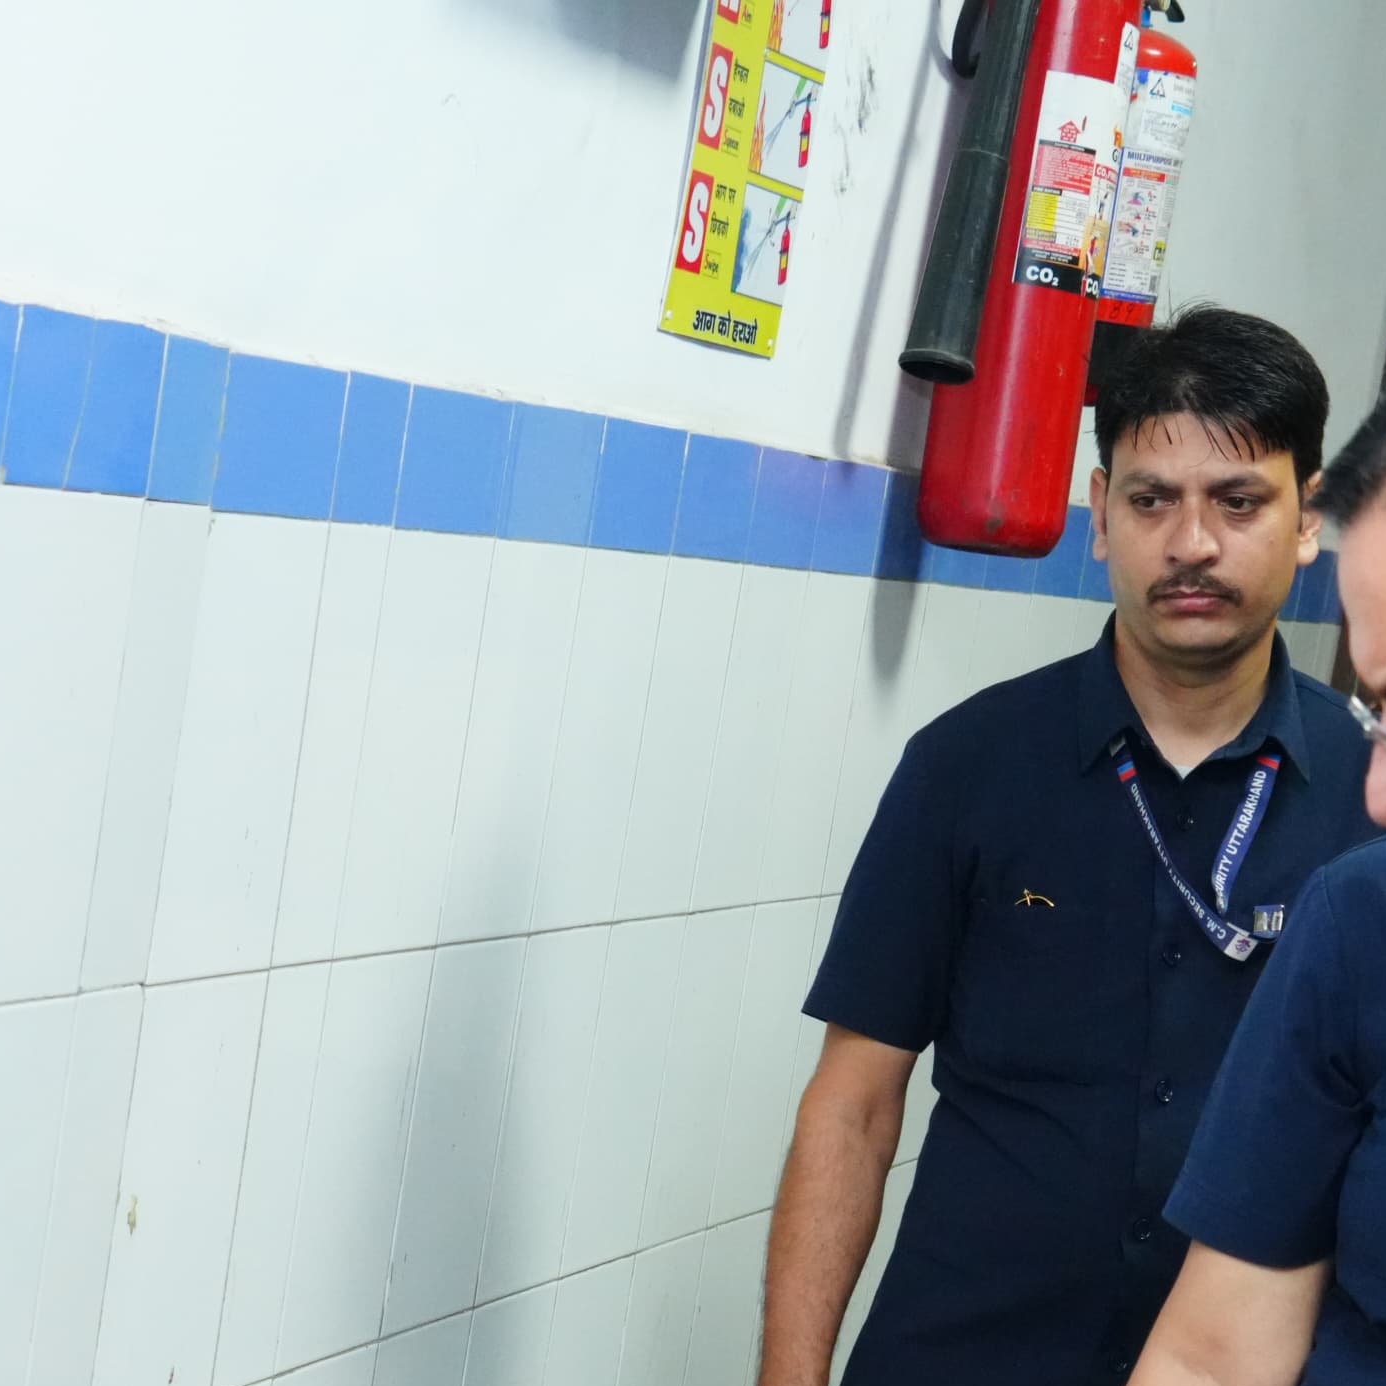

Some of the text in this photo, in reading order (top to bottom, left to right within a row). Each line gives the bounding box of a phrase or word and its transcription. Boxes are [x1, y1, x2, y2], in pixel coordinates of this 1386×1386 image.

[703, 55, 729, 139] S
[681, 181, 710, 263] S
[715, 183, 737, 205] आग पर
[704, 254, 720, 274] Swipe
[693, 310, 758, 345] आग को हराओ
[1131, 783, 1168, 867] UTTARAKHAND
[1225, 770, 1267, 855] UTTARAKHAND
[1168, 868, 1205, 919] SECURITY
